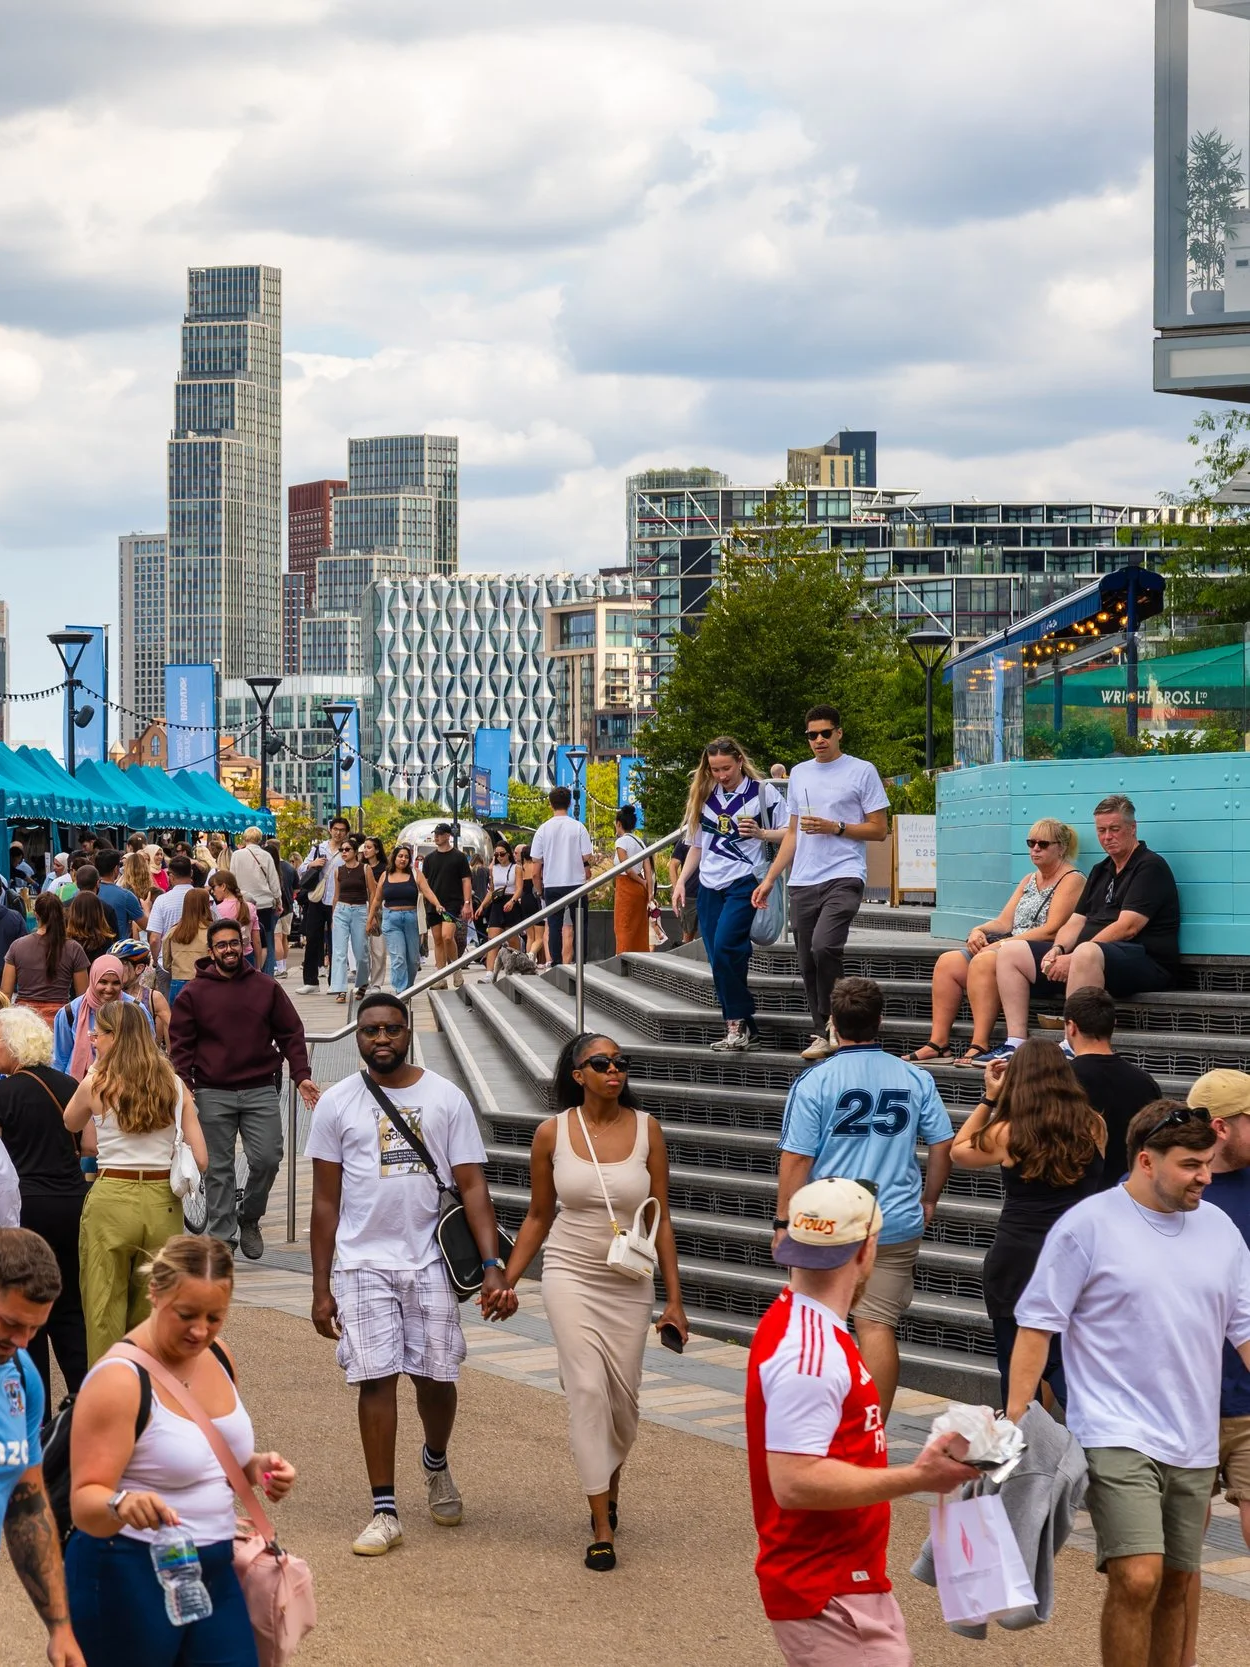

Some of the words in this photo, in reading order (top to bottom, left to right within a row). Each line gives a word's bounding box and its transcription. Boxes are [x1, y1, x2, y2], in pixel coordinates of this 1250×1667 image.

[1101, 690, 1152, 704] WRIHT
[915, 848, 936, 857] £25
[831, 1088, 911, 1137] 25
[793, 1212, 836, 1235] Crows
